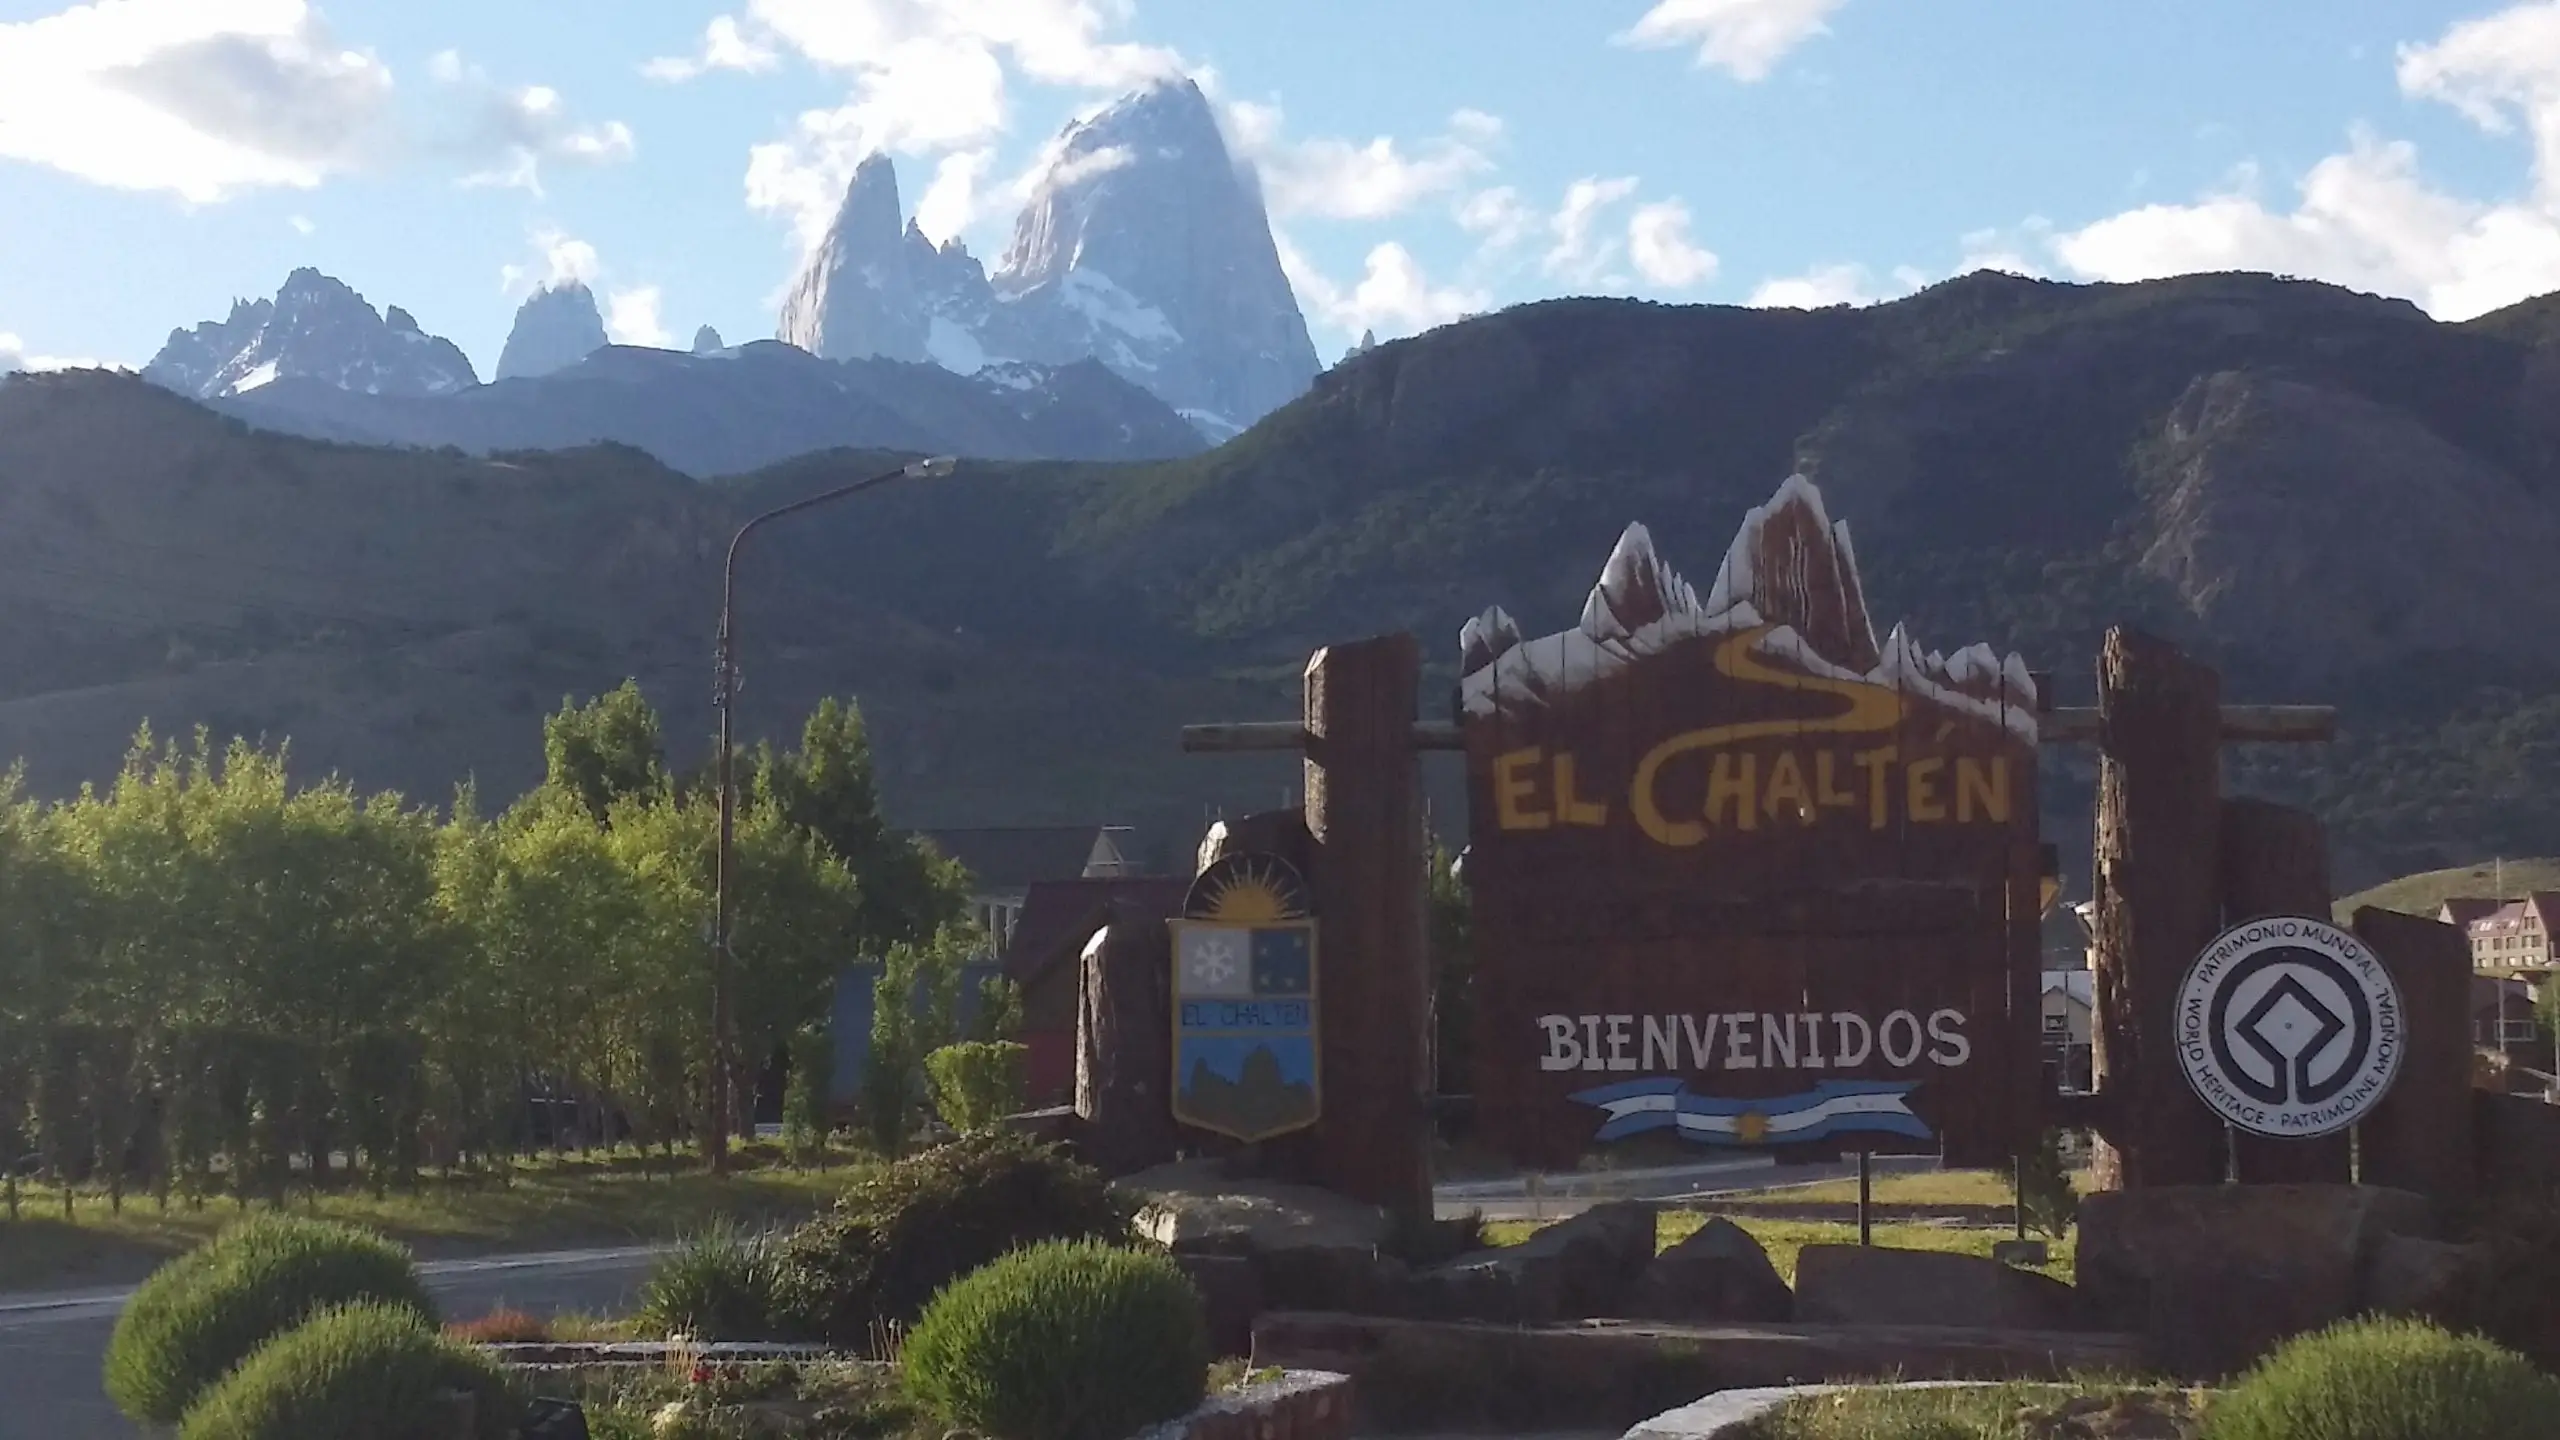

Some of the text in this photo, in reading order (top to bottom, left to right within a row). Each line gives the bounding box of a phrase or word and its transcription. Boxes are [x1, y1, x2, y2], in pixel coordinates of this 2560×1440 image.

[1492, 721, 2011, 846] EL CHALTÉN
[2200, 922, 2377, 984] PATRIMONIO MUNDIAL
[1182, 1004, 1206, 1026] EL
[1537, 1008, 1971, 1071] BIENVENIDOS
[2185, 998, 2265, 1125] WORLD HERITAGE
[2281, 987, 2395, 1128] PATRIMOINE MONDIAL
